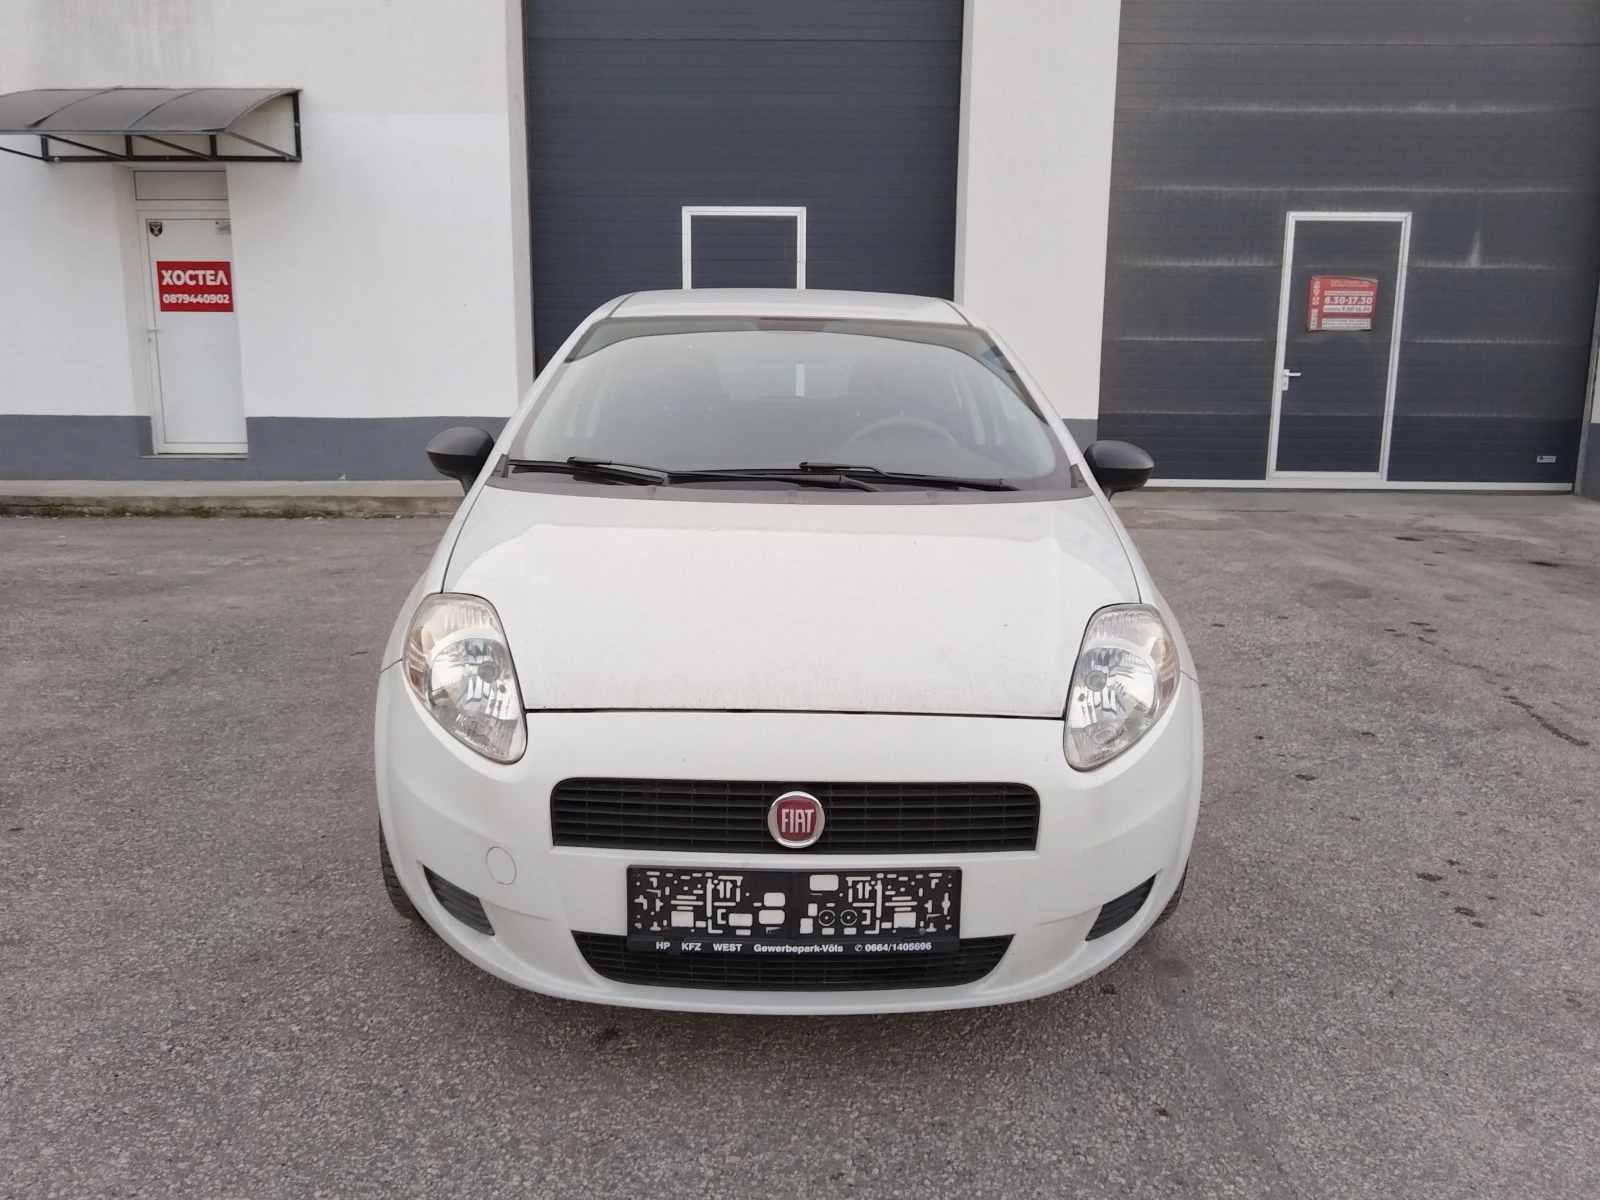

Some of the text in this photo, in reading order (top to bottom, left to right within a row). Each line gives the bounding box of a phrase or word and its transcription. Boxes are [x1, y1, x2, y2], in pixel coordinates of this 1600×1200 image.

[161, 269, 229, 286] ХОСТЕЛ
[162, 293, 230, 304] 0879440902
[1324, 296, 1373, 305] 8.30-17.30
[781, 808, 815, 834] FIAT
[655, 941, 932, 955] HP KFZ WEST Gewerbepark-Völs 0664/1405696
